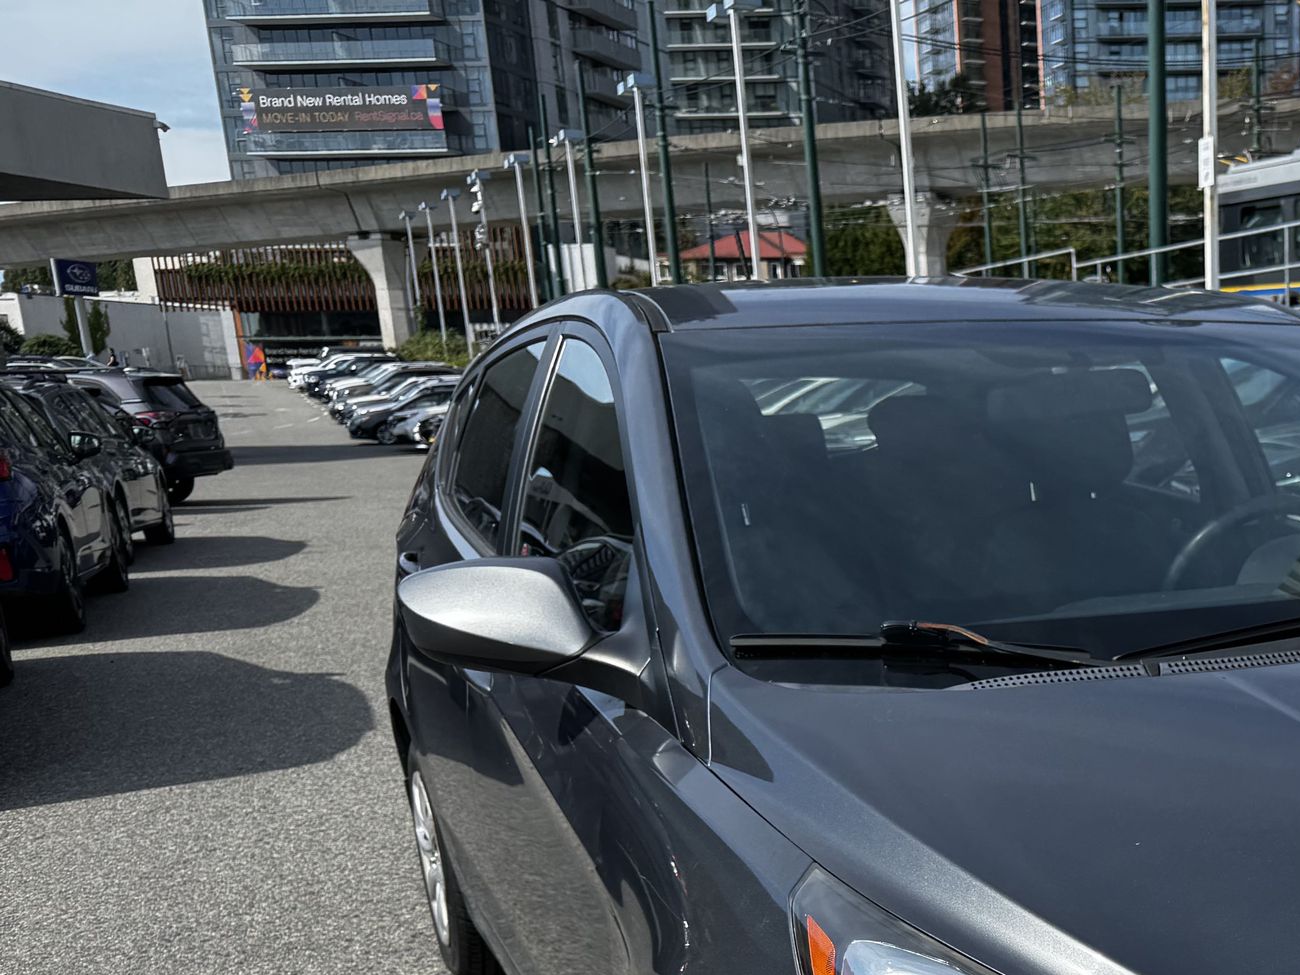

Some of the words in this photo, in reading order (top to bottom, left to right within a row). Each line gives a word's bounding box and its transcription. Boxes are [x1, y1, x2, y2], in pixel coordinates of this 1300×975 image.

[259, 94, 294, 108] Brand
[296, 95, 323, 107] New
[325, 92, 363, 107] Rental
[365, 93, 408, 106] Homes
[262, 112, 311, 124] MOVE-IN
[315, 111, 350, 123] TODAY
